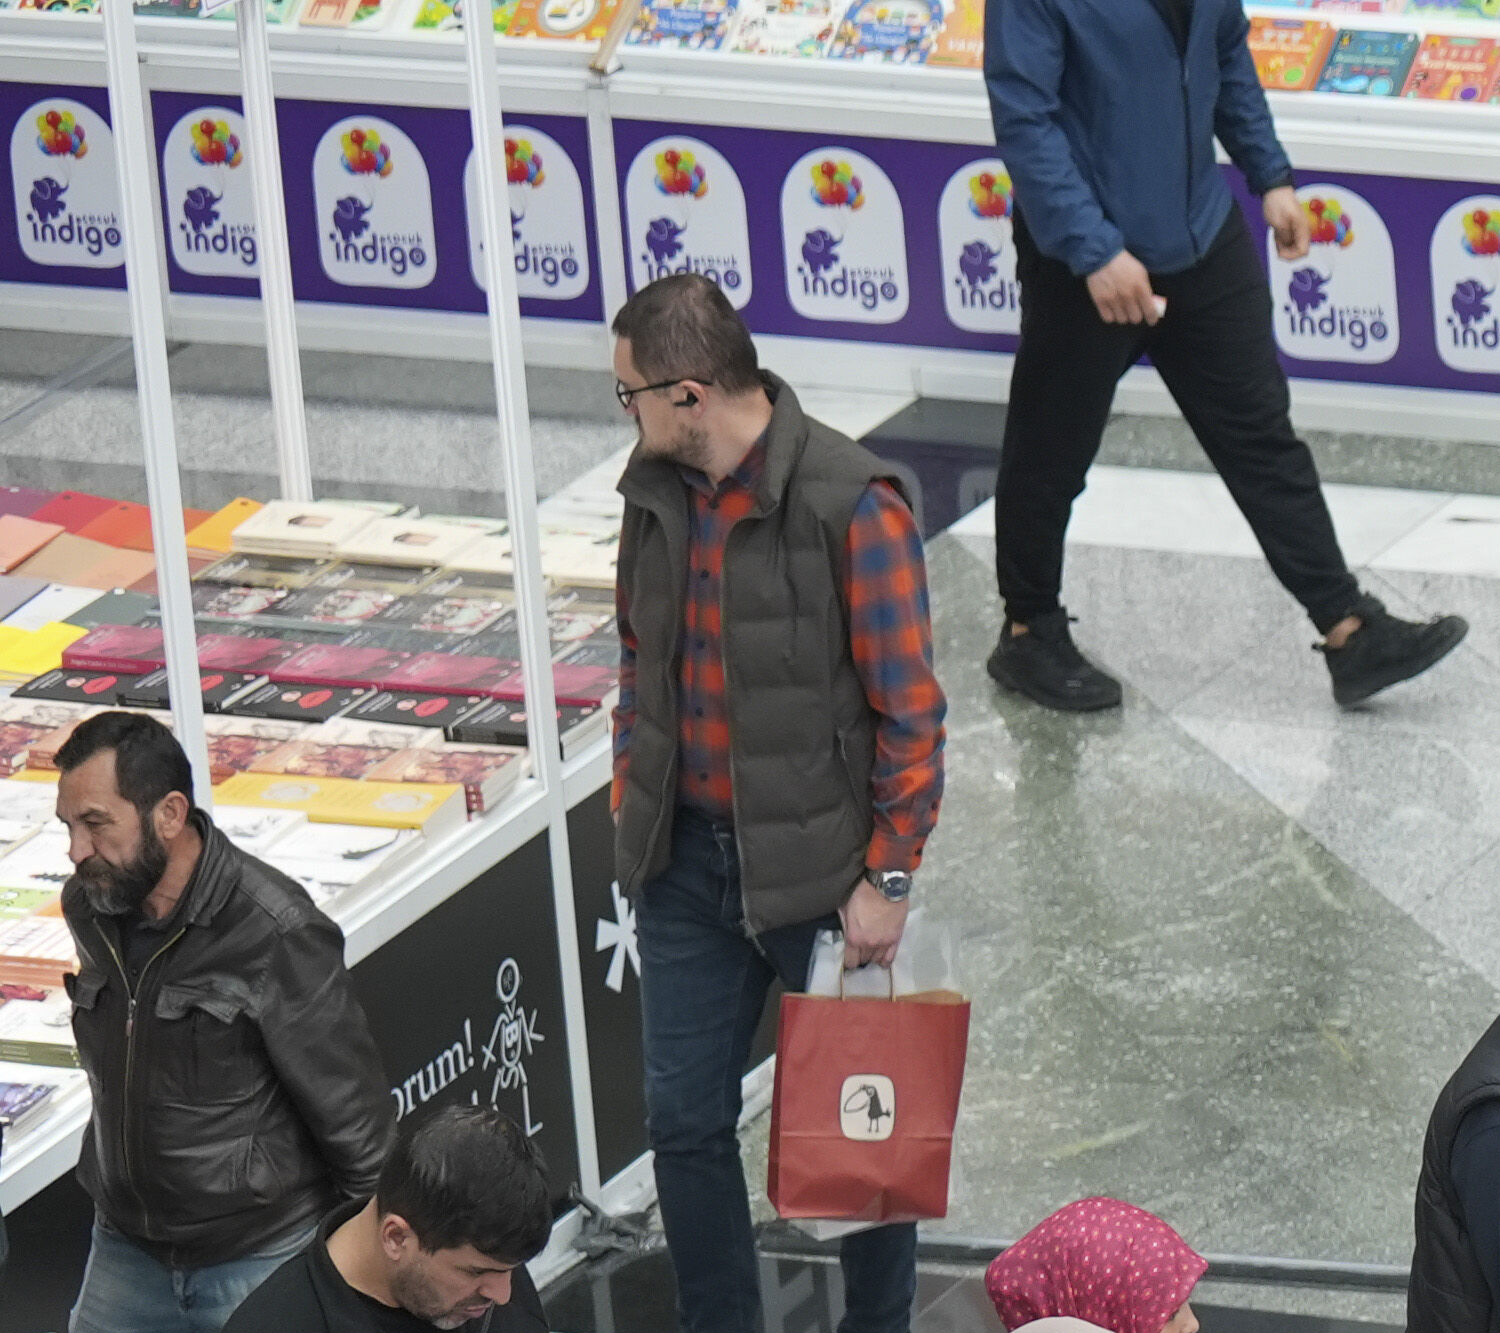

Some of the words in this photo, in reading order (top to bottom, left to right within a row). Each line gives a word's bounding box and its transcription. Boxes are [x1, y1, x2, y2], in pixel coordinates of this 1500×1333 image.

[26, 212, 121, 257] indigo
[180, 222, 258, 265] indig
[328, 233, 426, 276] indigo
[798, 266, 898, 311] indigo
[1285, 305, 1388, 350] indigo
